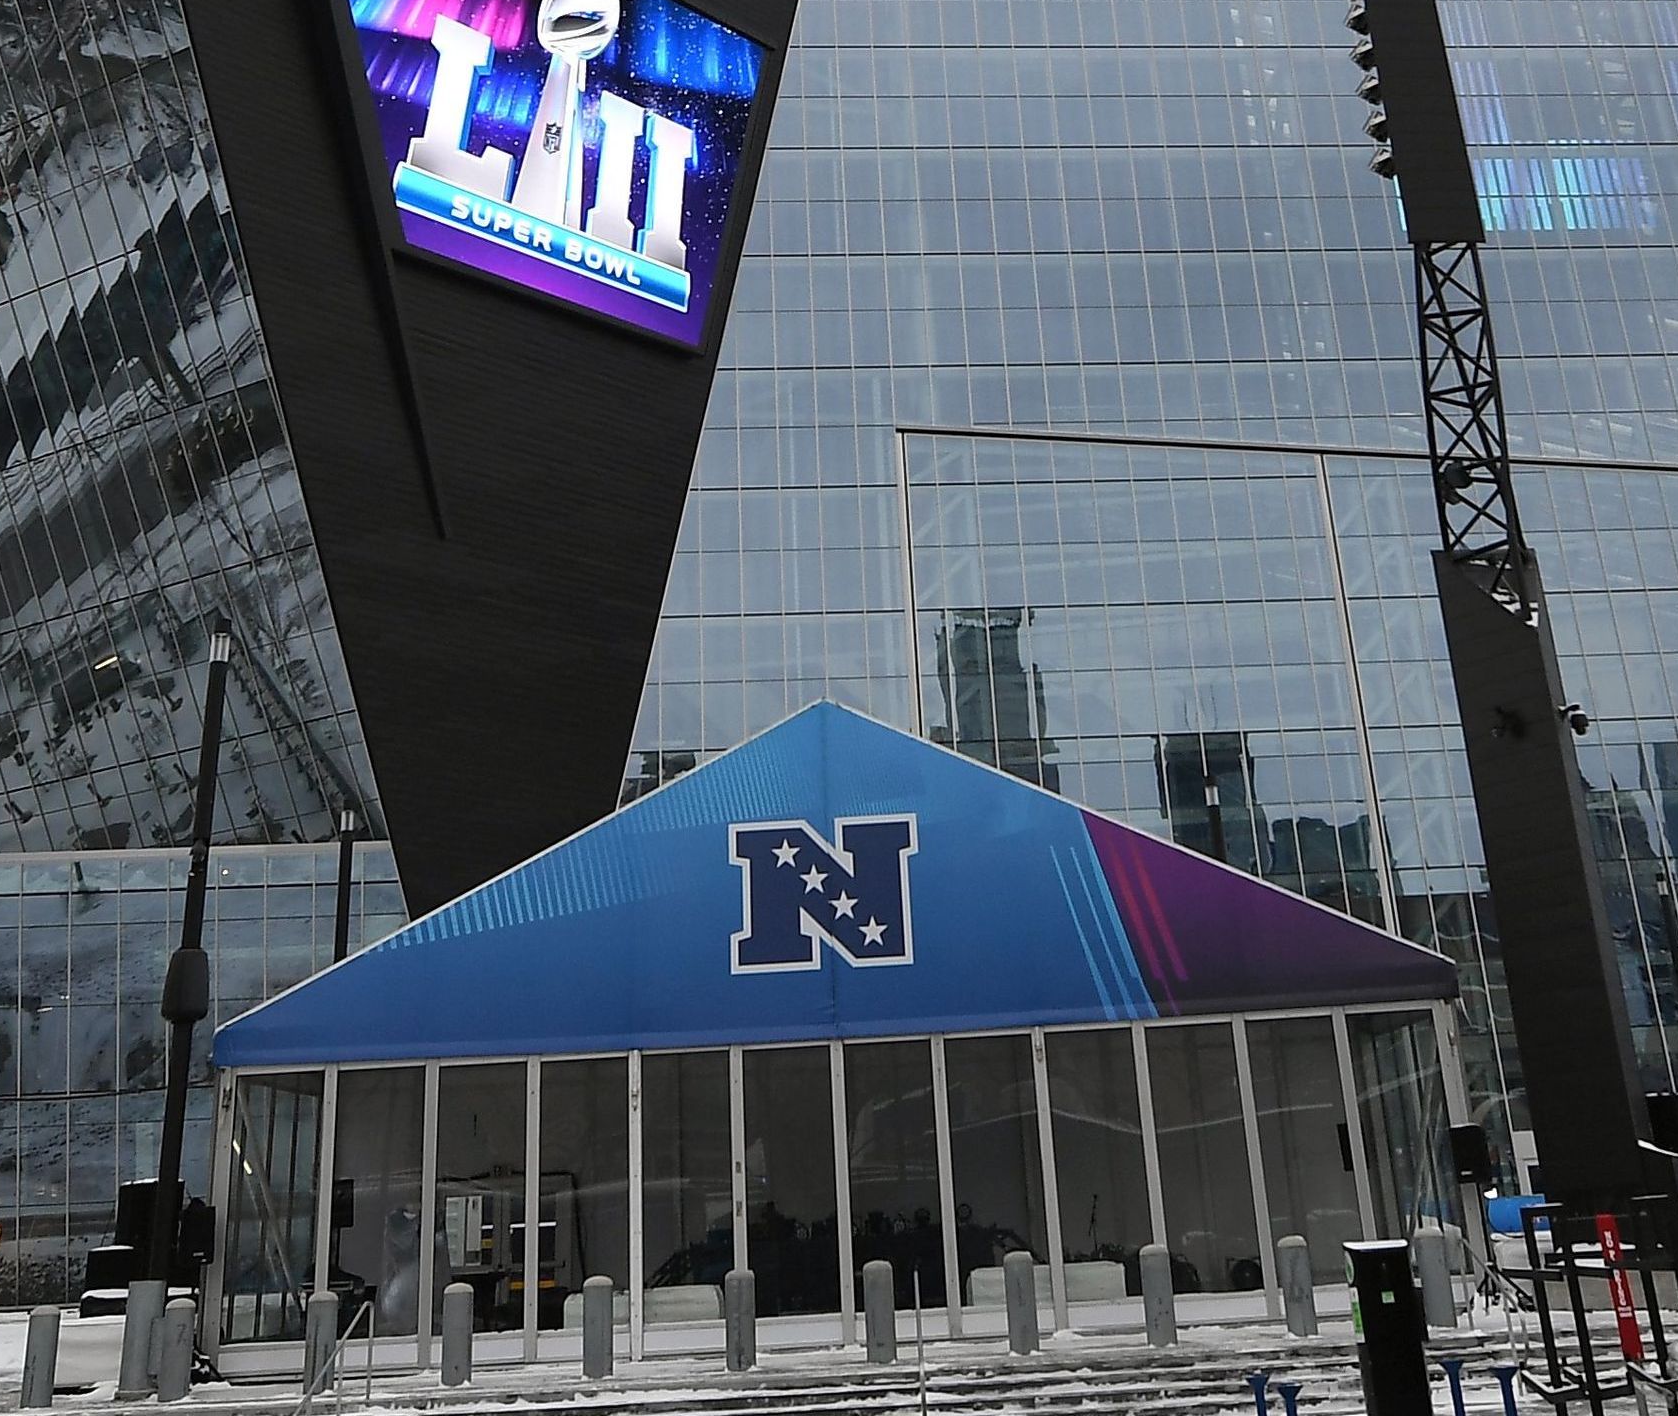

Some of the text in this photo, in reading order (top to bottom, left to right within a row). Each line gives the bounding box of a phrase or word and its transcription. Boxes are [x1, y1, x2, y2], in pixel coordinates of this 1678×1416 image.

[450, 195, 642, 286] SUPER BOWL
[728, 813, 919, 975] N
[1609, 1249, 1627, 1306] PRKING
